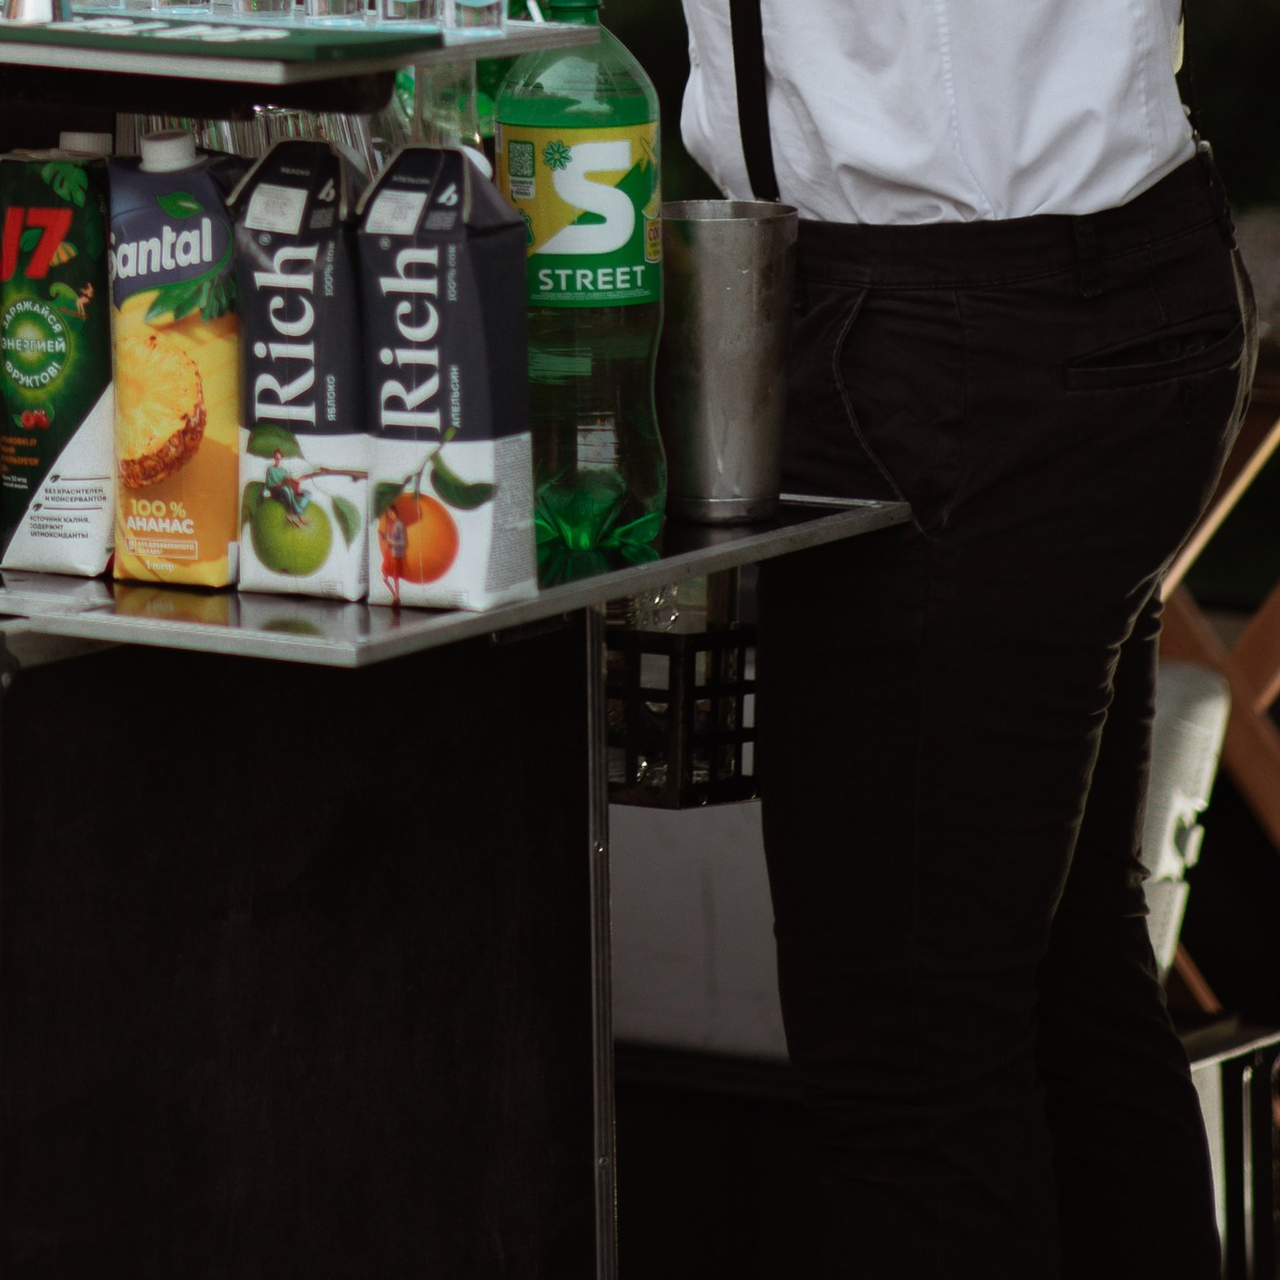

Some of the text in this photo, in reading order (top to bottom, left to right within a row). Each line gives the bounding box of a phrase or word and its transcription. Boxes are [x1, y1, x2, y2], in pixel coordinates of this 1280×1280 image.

[538, 265, 646, 292] STREET
[2, 300, 64, 334] ЗАРЯЖАЙСЯ
[254, 241, 320, 427] Rich
[379, 244, 441, 434] Rich
[5, 360, 62, 388] ФРУКТОВ!
[326, 373, 336, 422] ЯБЛОКО
[449, 364, 461, 429] АПЕЛЬСИН
[127, 515, 195, 535] АНАНАС
[130, 499, 167, 517] 100
